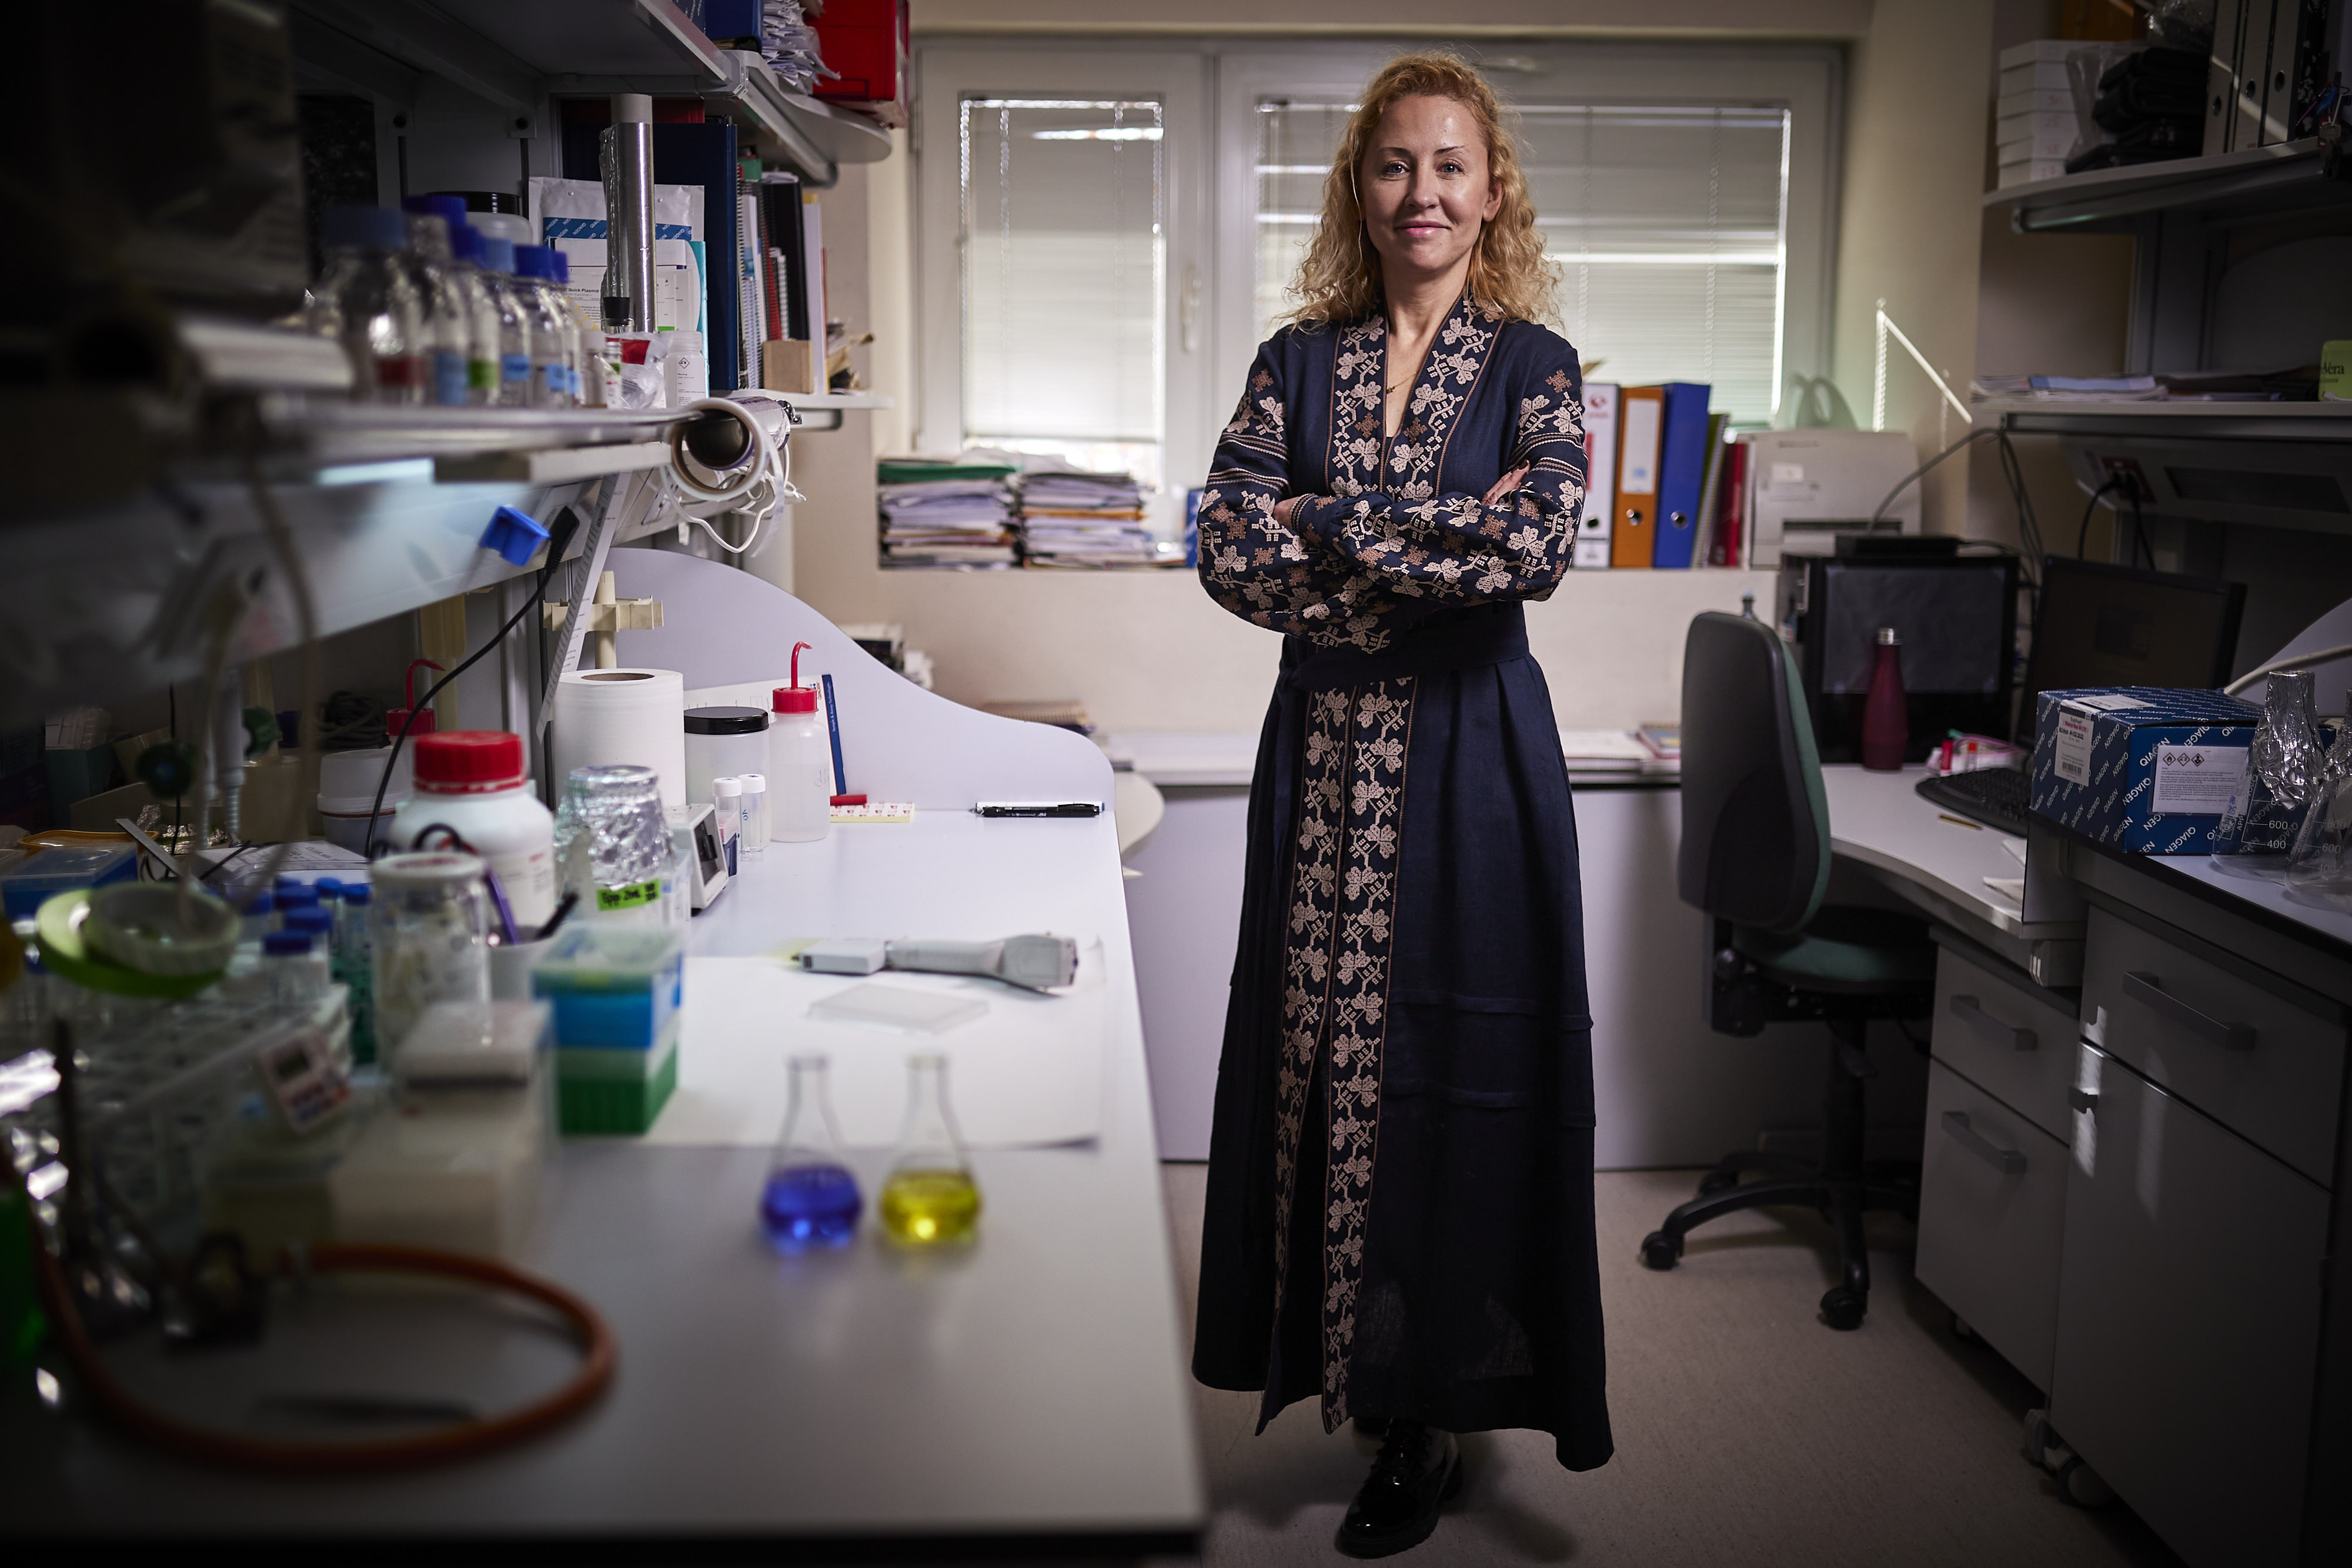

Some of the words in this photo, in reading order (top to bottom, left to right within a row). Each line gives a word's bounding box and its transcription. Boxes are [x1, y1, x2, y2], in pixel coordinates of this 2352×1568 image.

[572, 222, 587, 236] QIAGEN
[2104, 724, 2120, 750] QIAGEN
[2094, 760, 2110, 785] QIAGEN
[2112, 751, 2129, 777] QIAGEN
[2103, 788, 2119, 814] QIAGEN
[2122, 777, 2152, 806] QIAGEN
[2071, 804, 2084, 828] QIAGEN
[2087, 796, 2101, 822] QIAGEN
[2113, 816, 2134, 842] QIAGEN
[2268, 820, 2288, 830] 600
[2164, 826, 2197, 854] QIAGEN
[2266, 839, 2287, 850] 400
[2322, 842, 2341, 854] 600
